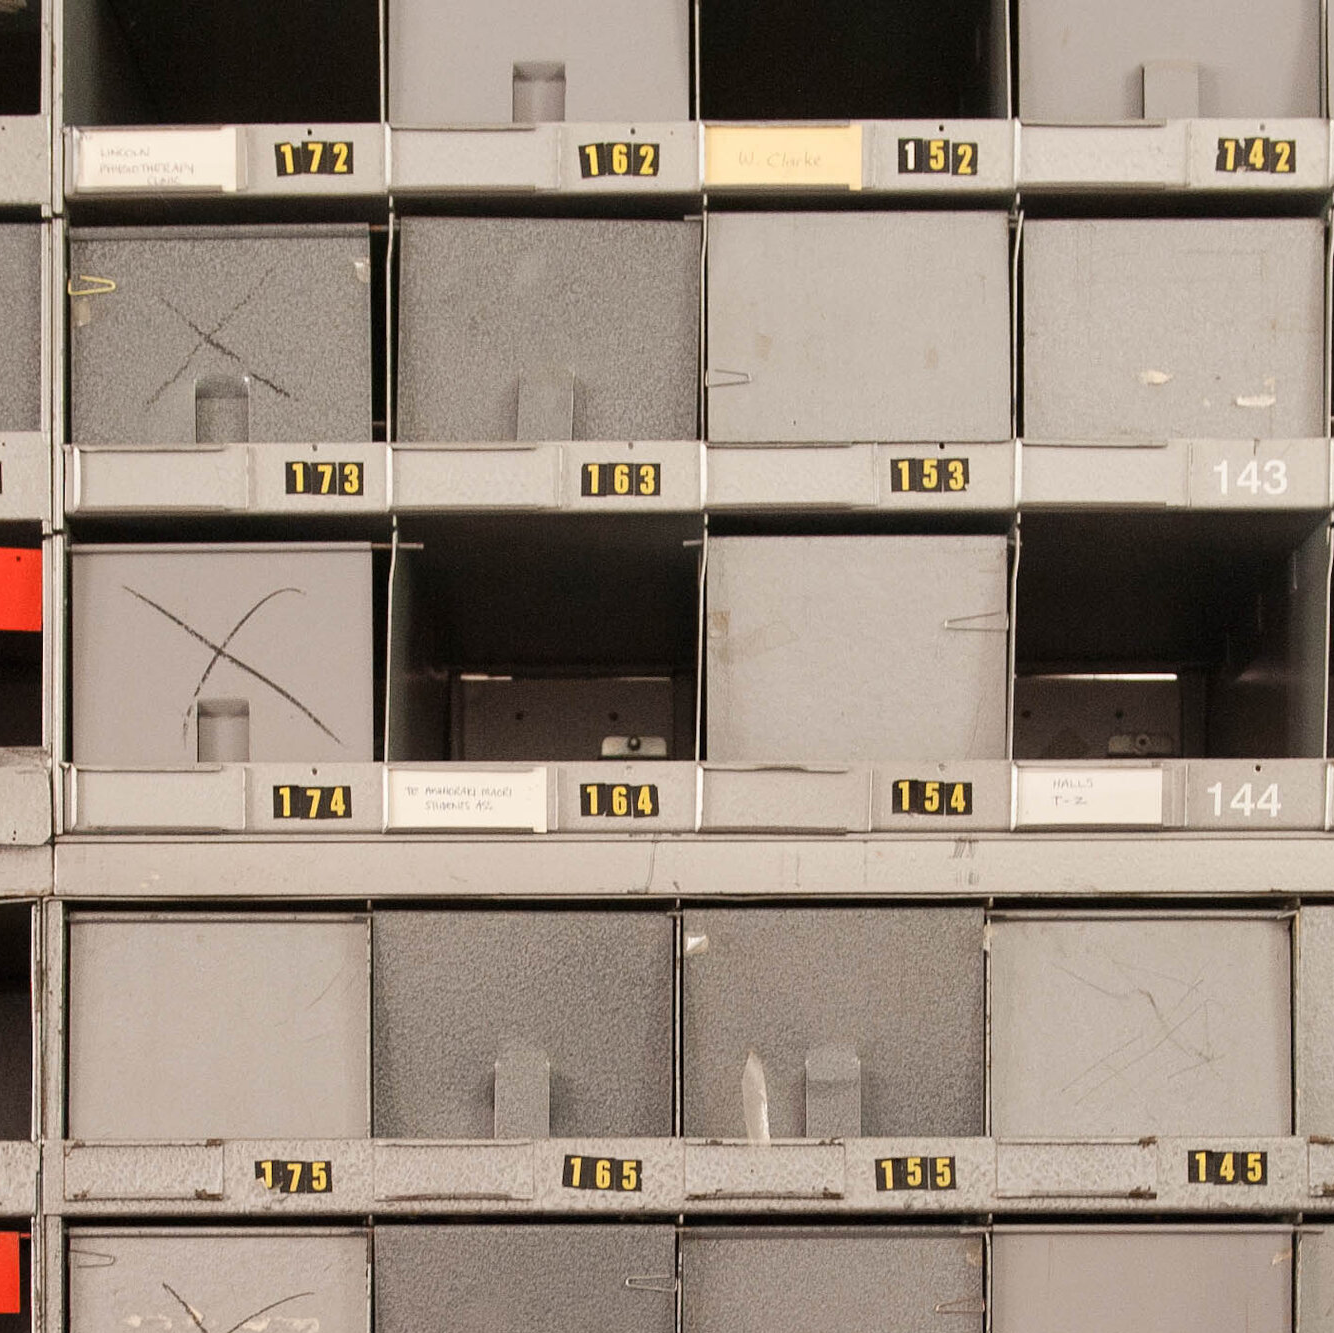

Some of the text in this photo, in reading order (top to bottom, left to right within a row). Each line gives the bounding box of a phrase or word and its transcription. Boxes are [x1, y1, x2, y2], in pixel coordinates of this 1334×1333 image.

[280, 141, 348, 174] 172
[585, 143, 654, 176] 162
[767, 151, 822, 169] Clarke
[903, 139, 973, 175] 152
[1224, 138, 1290, 172] 142
[292, 462, 359, 494] 173
[588, 464, 655, 495] 163
[898, 458, 964, 491] 153
[1213, 460, 1287, 495] 143
[587, 784, 652, 816] 164
[899, 781, 966, 812] 154
[1053, 778, 1093, 789] HALLS
[1206, 782, 1282, 818] 144
[279, 786, 345, 819] 174
[261, 1160, 327, 1192] 175
[571, 1157, 637, 1190] 165
[881, 1156, 951, 1189] 155
[1195, 1152, 1262, 1182] 145
